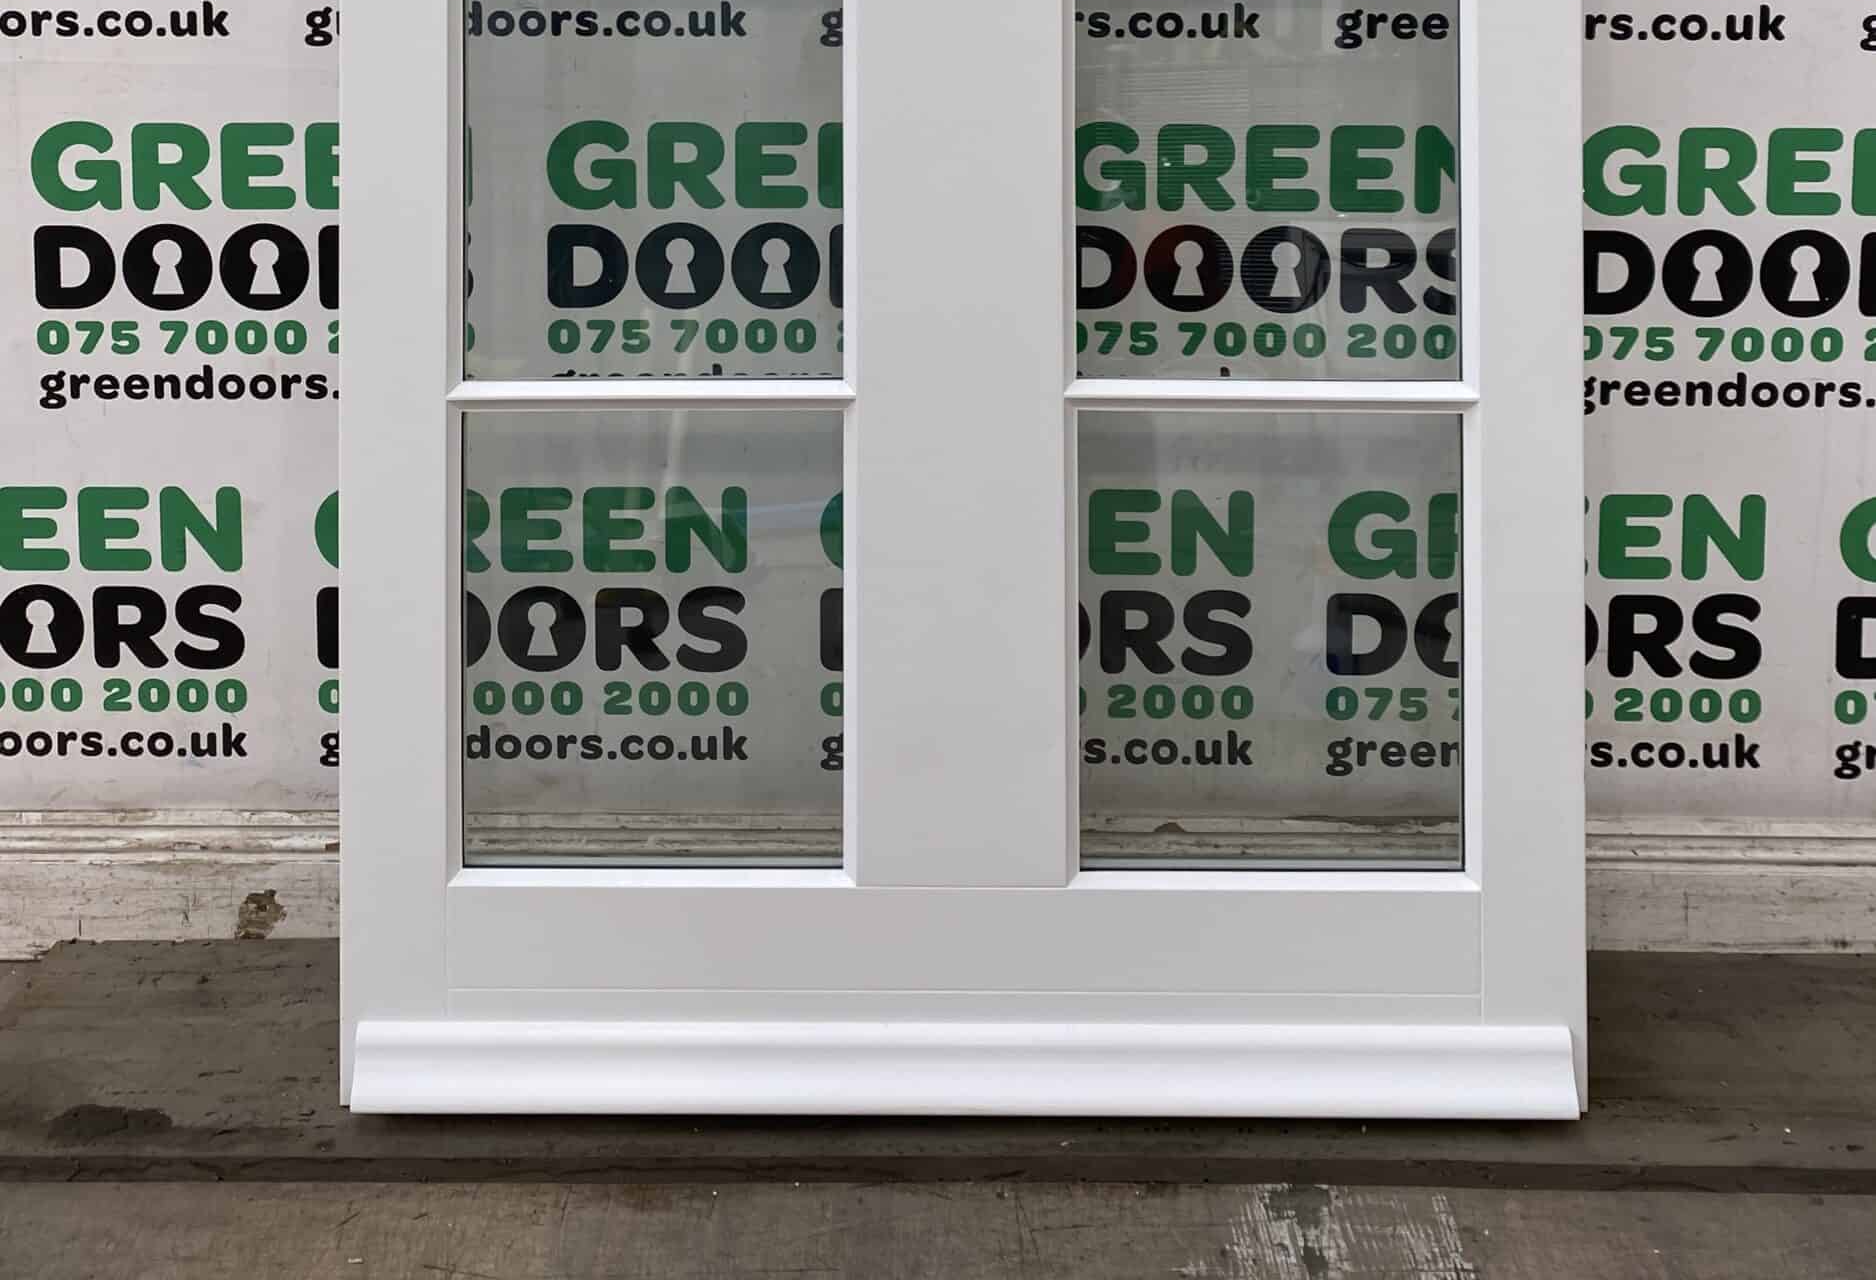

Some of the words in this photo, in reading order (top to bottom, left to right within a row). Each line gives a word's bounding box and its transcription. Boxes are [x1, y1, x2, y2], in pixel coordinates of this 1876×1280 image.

[1334, 9, 1450, 49] gree
[1584, 5, 1786, 41] rs.co.uk
[33, 223, 339, 312] DOO
[547, 222, 843, 310] DOO
[1584, 229, 1876, 318] DOO
[37, 321, 141, 355] 075
[159, 320, 308, 355] 7000
[547, 319, 650, 354] 075
[670, 319, 816, 354] 7000
[1178, 322, 1327, 358] 7000
[1695, 327, 1843, 362] 7000
[0, 486, 243, 572] EEN
[1088, 489, 1254, 577] EN
[1585, 494, 1767, 581] EN
[0, 584, 245, 669] ORS
[1079, 590, 1253, 676] RS
[1585, 593, 1762, 679] RS
[0, 678, 83, 712] 00
[103, 678, 248, 713] 2000
[473, 681, 583, 716] 000
[603, 681, 749, 716] 2000
[1108, 684, 1254, 719] 2000
[1325, 686, 1428, 721] 075
[1614, 688, 1761, 723] 2000
[1834, 690, 1876, 724] 0
[1081, 730, 1253, 765] s.co.uk
[1586, 733, 1760, 768] s.co.uk
